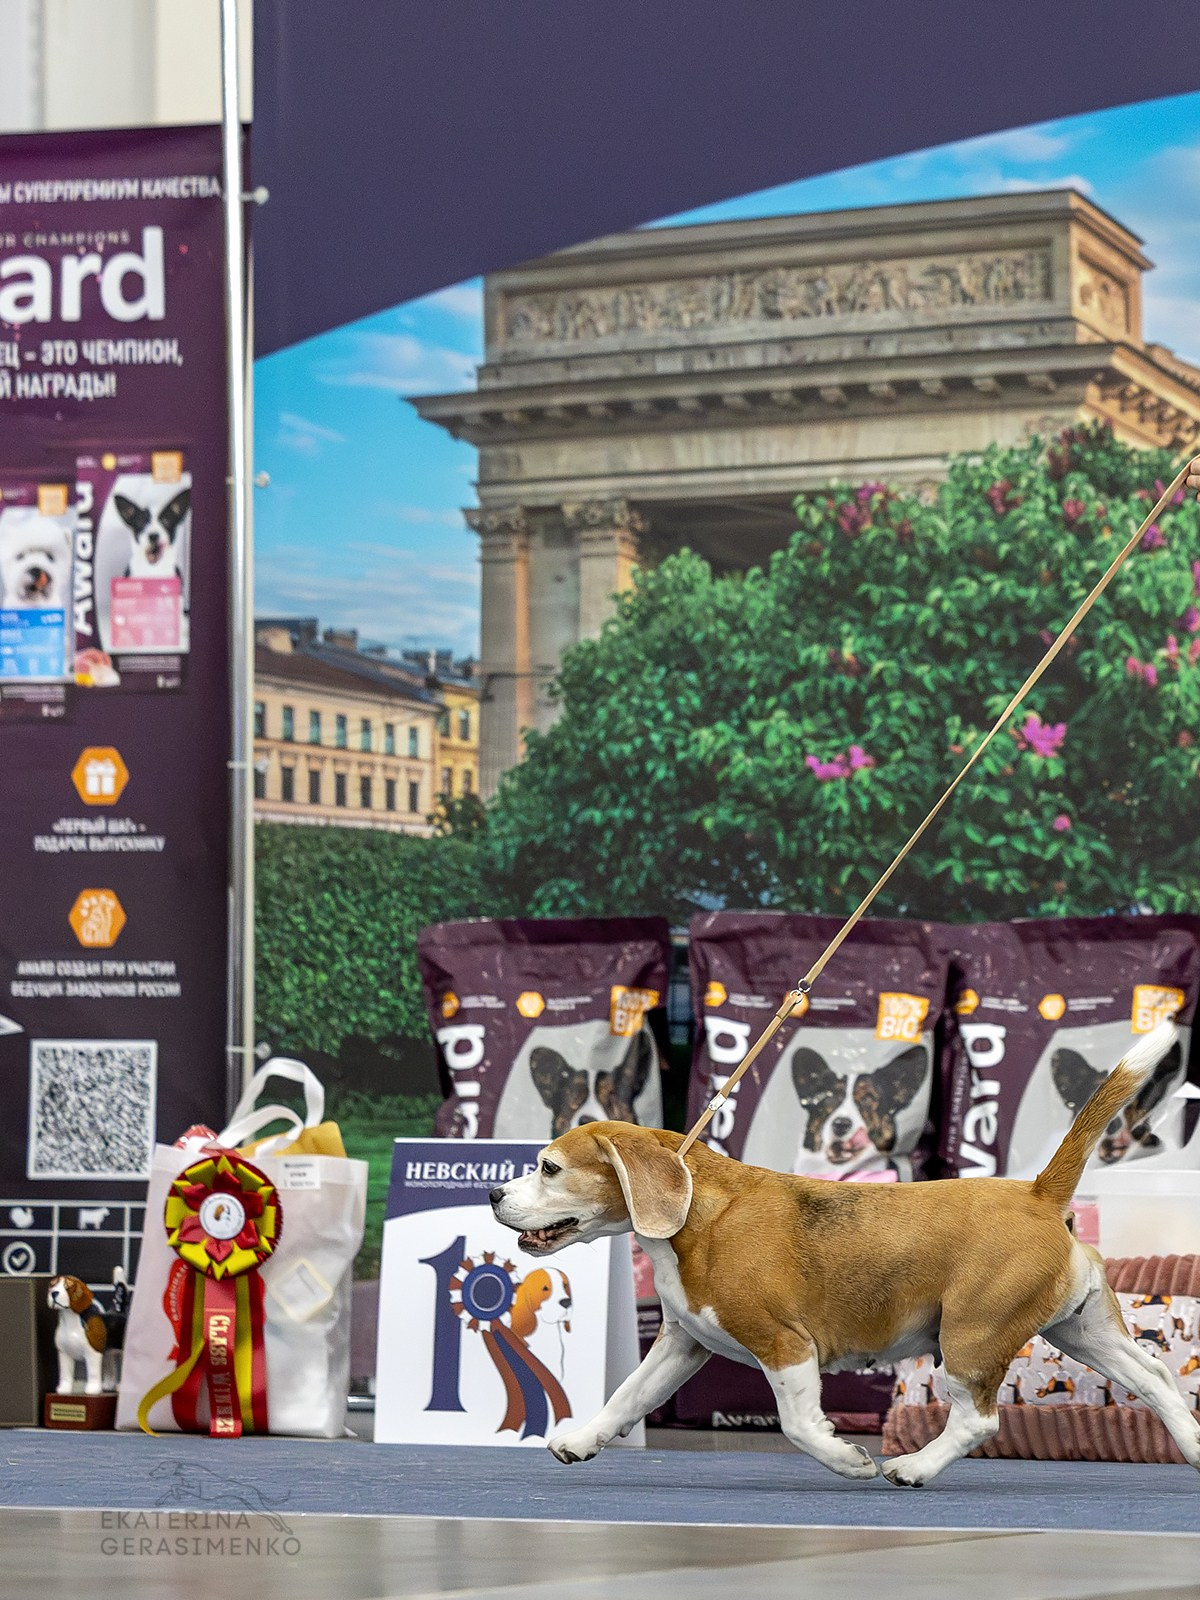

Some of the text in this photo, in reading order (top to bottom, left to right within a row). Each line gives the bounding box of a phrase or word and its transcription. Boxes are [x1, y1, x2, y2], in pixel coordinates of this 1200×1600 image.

[14, 178, 139, 203] СУПЕРПРЕМИУМ
[142, 176, 222, 199] КАЧЕСТВА
[22, 230, 130, 248] CHAMPIONS
[41, 339, 78, 366] ЭТО
[82, 338, 184, 367] ЧЕМПИОН,
[16, 372, 117, 401] НАГРАДЫ!
[881, 1016, 919, 1038] BIO
[405, 1159, 515, 1181] НЕВСКИЙ
[418, 1236, 467, 1413] 1
[208, 1314, 232, 1366] CLASS
[712, 1411, 781, 1428] Awar
